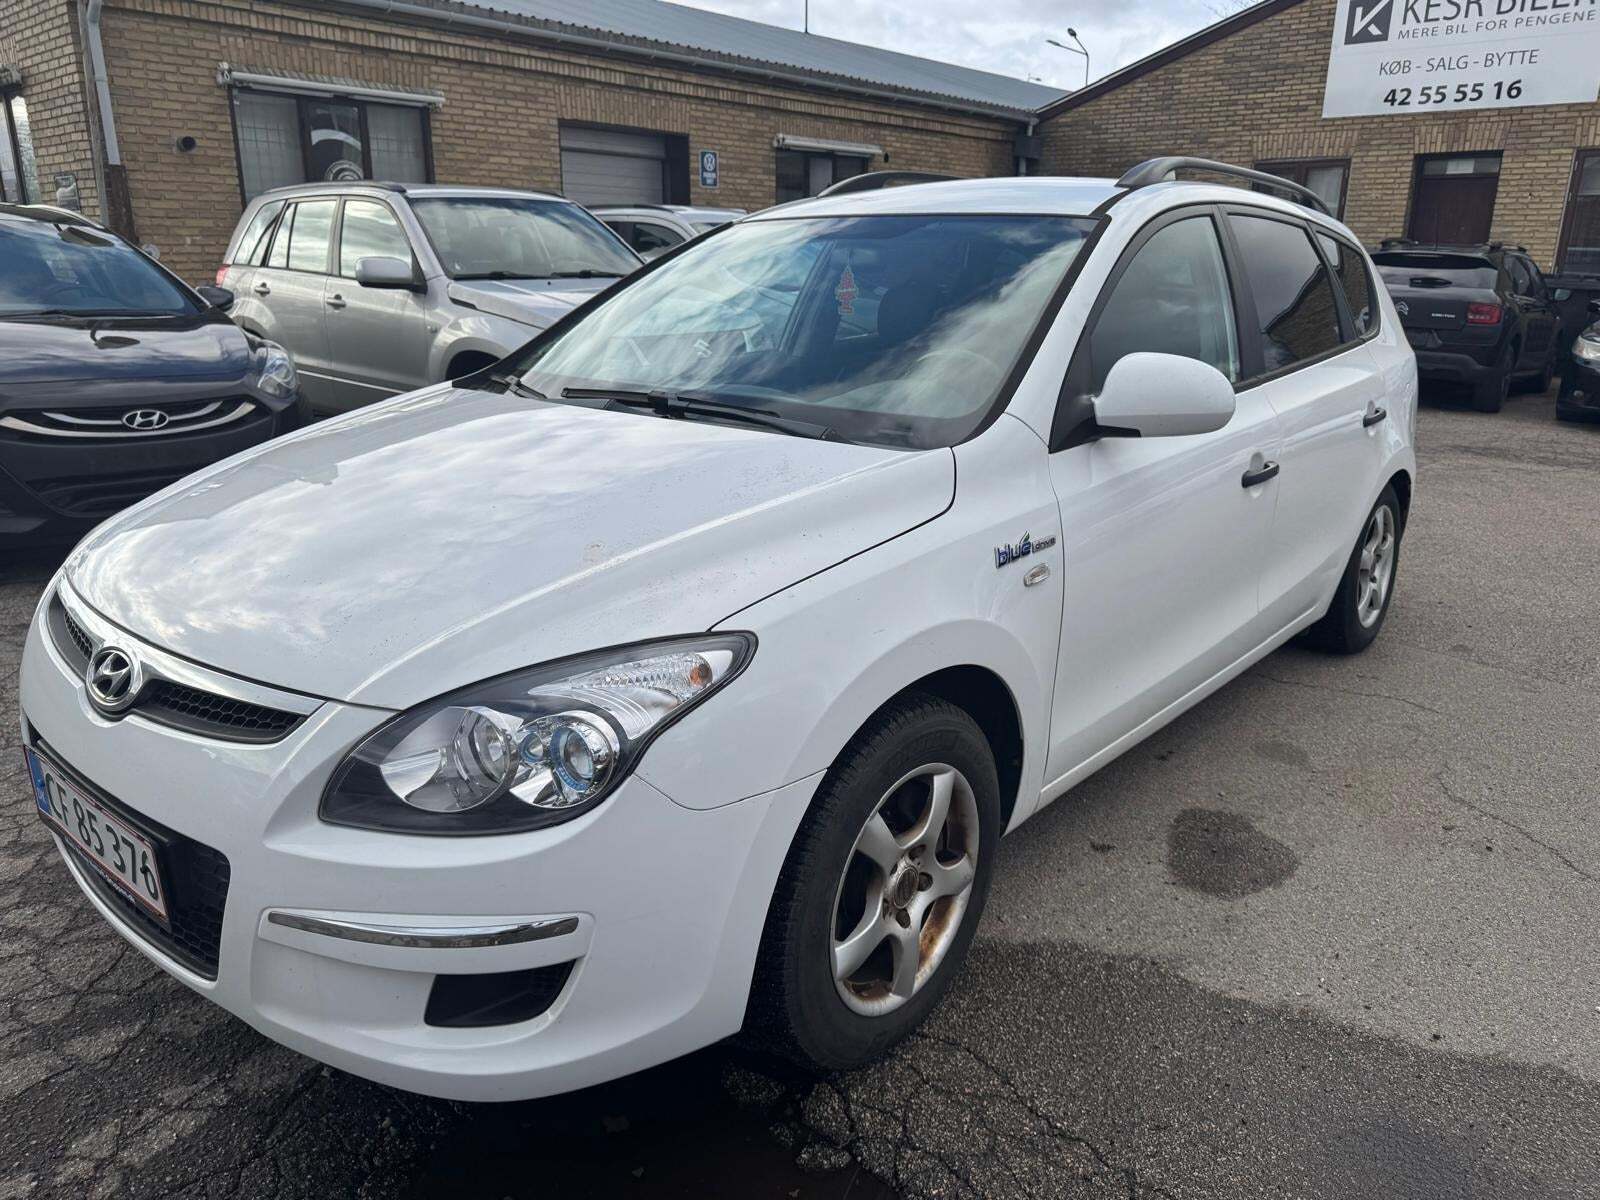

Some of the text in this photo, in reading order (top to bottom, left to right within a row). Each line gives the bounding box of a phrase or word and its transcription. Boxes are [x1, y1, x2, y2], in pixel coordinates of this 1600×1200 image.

[1398, 9, 1597, 40] MERE BIL FOR PENGENE
[1378, 60, 1411, 77] KØB
[1426, 54, 1469, 73] SALG
[1483, 48, 1540, 69] BYTTE
[1383, 79, 1522, 107] 42 55 55 16
[45, 772, 67, 826] CF
[73, 798, 104, 858] 85
[106, 823, 158, 900] 376
